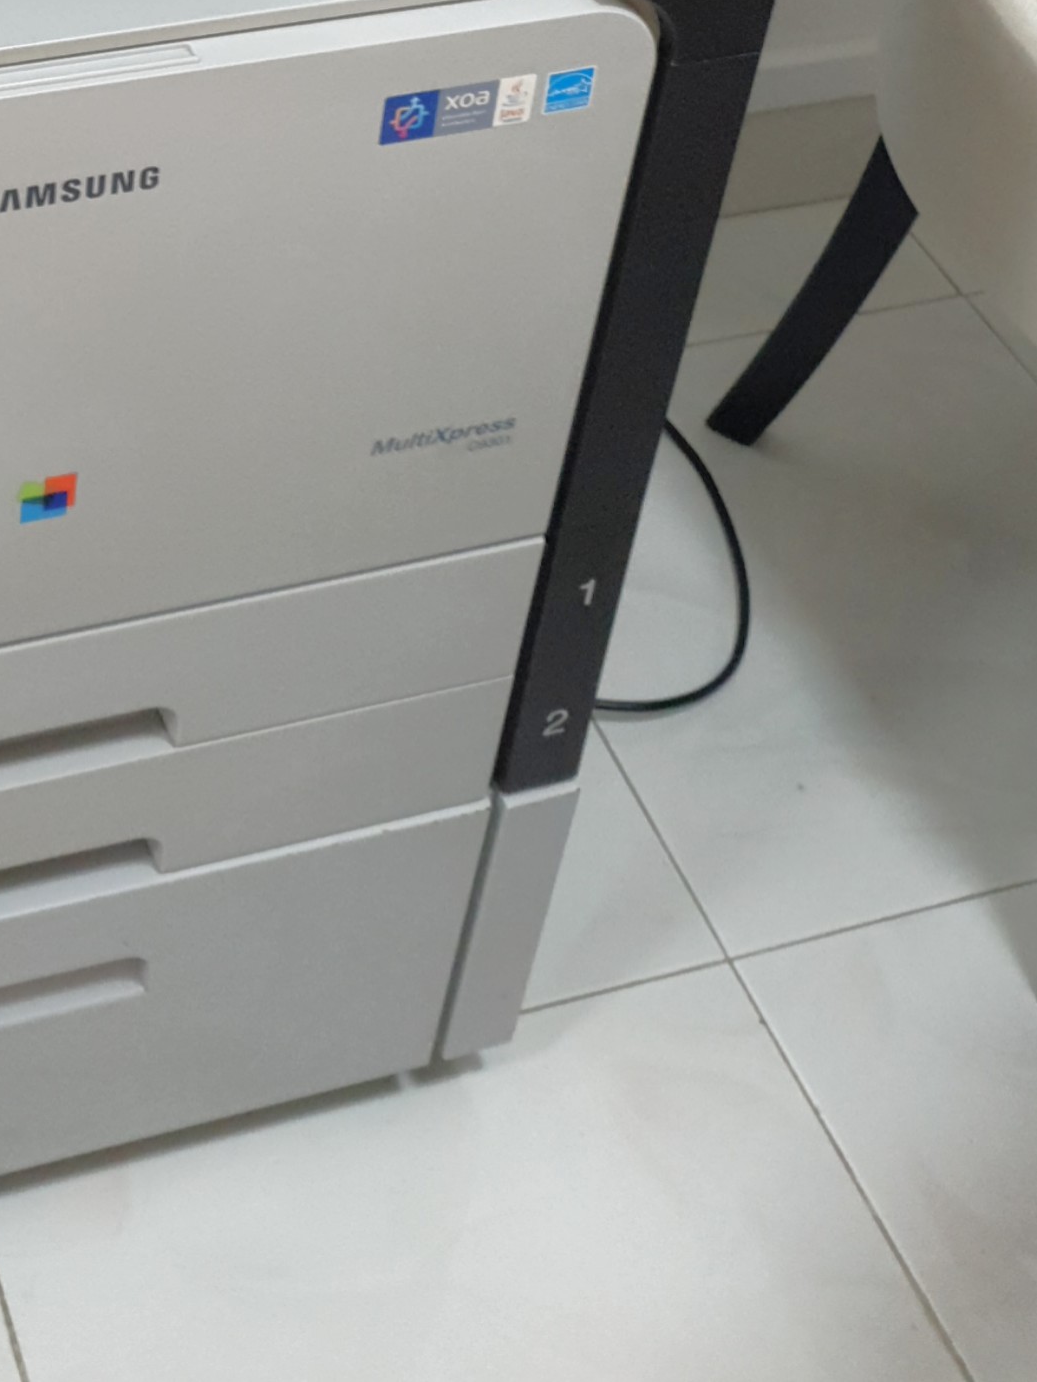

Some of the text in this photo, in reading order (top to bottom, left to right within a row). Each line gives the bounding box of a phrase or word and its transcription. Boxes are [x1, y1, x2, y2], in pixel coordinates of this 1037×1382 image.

[370, 417, 516, 456] MultiXpress
[579, 578, 597, 606] 1
[542, 708, 569, 737] 2
